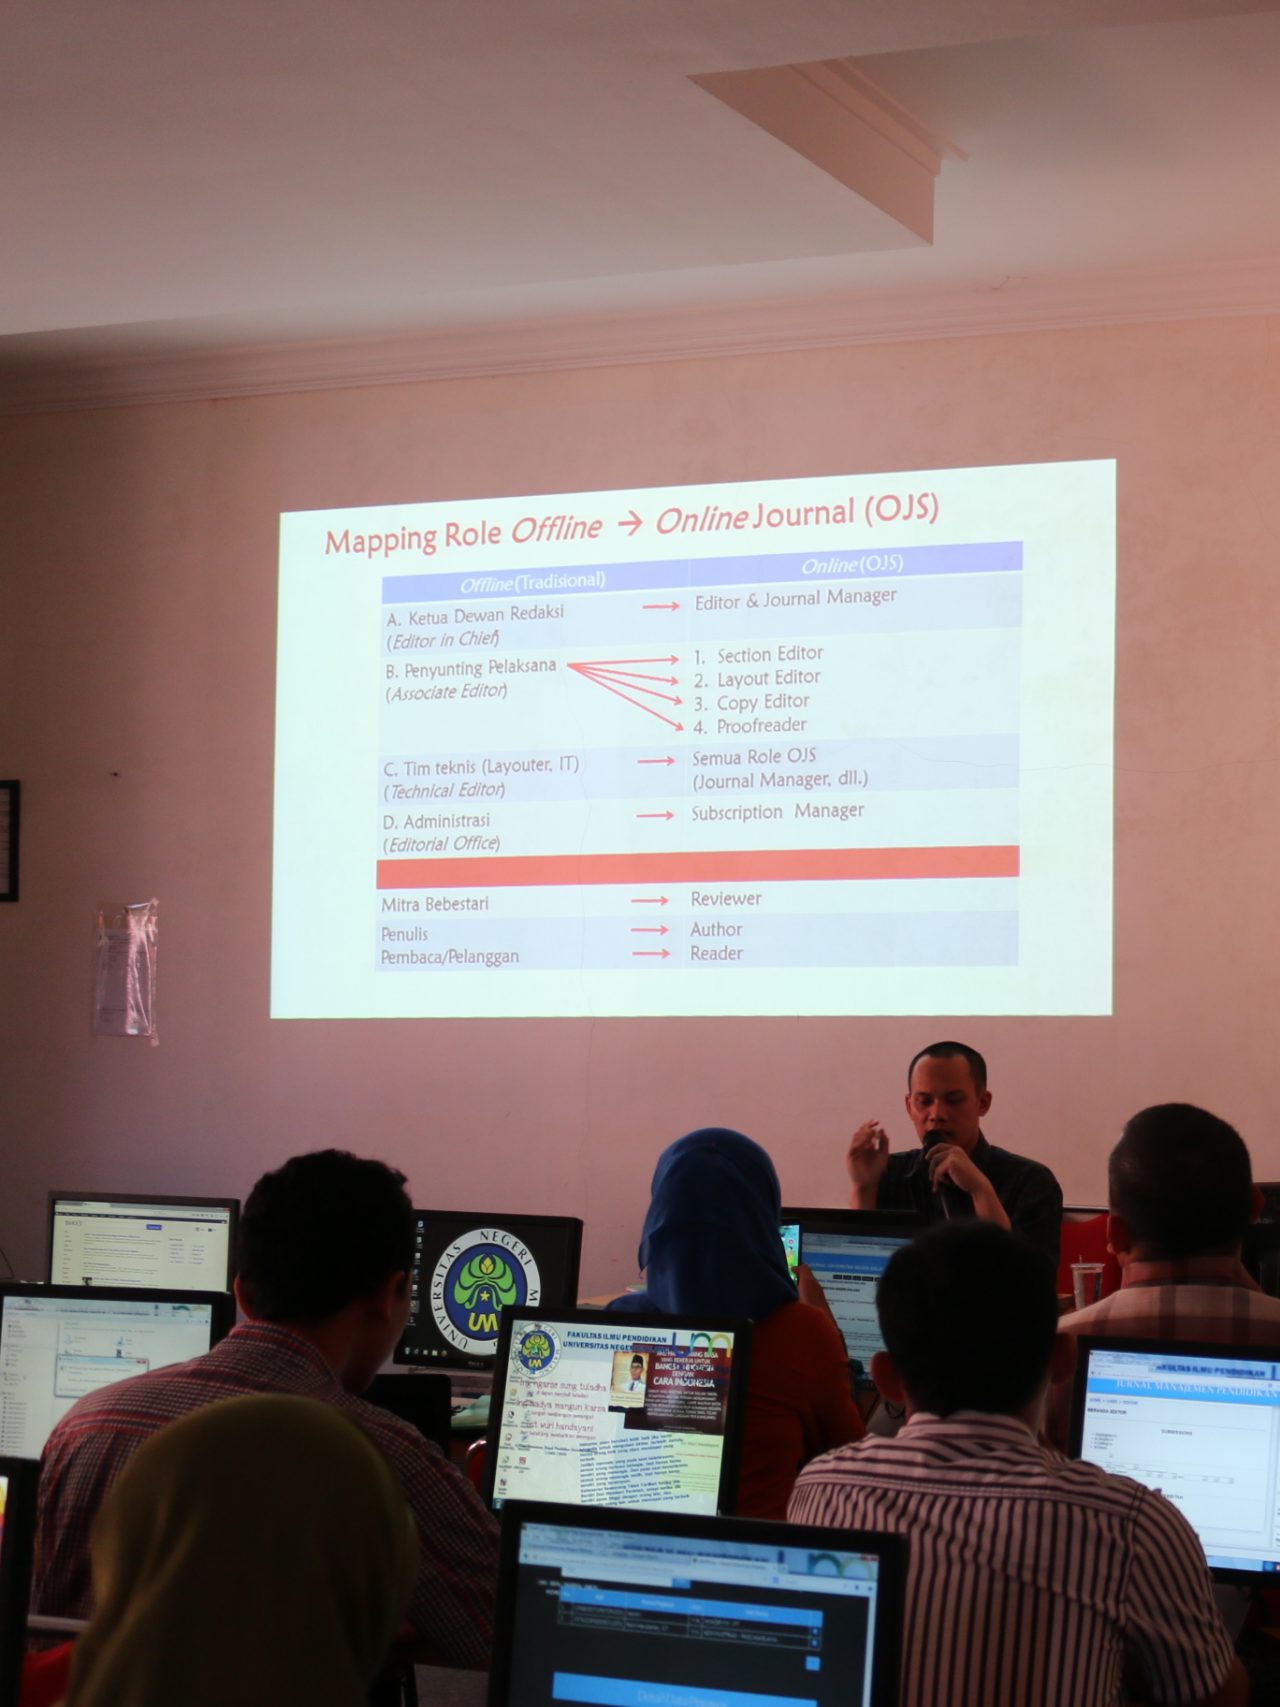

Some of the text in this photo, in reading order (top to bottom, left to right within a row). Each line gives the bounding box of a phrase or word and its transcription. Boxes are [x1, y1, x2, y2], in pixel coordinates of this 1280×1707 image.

[324, 492, 939, 559] Mapping Role Offline Online Journal (OJS)
[695, 587, 898, 612] Editor & Journal Manager
[386, 604, 565, 627] A. Ketua Dewan Redaksi
[386, 629, 500, 652] (Editor in Chief)
[694, 645, 824, 665] 1. Section Editor
[385, 658, 557, 680] B. Penyunting Pelaksana
[694, 668, 821, 689] 2. Layout Editor
[386, 683, 508, 704] (Associate Editor)
[694, 692, 810, 713] 3. Copy Editor
[693, 716, 808, 735] 4. Proofreader
[383, 755, 580, 778] C. Tim teknis (Layouter, IT)
[692, 747, 817, 767] Semua Role OJS
[383, 781, 506, 802] (Technical Editor)
[692, 770, 869, 792] (Journal Manager, dll.)
[383, 812, 490, 831] D. Administrasi
[692, 802, 865, 823] Subscription Manager
[383, 834, 500, 855] (Editorial Office)
[381, 895, 489, 913] Mitra Bebestari
[691, 891, 762, 907] Reviewer
[381, 926, 429, 943] Penulis
[690, 922, 743, 937] Author
[381, 949, 519, 968] Pembaca/Pelanggan
[690, 945, 743, 961] Reader
[432, 1230, 533, 1350] UNIVERSITAS NEGERI
[563, 1341, 609, 1350] UNIVERSITAS
[567, 1331, 602, 1339] FAKULTAS
[622, 1334, 667, 1343] PENDIDIKAN
